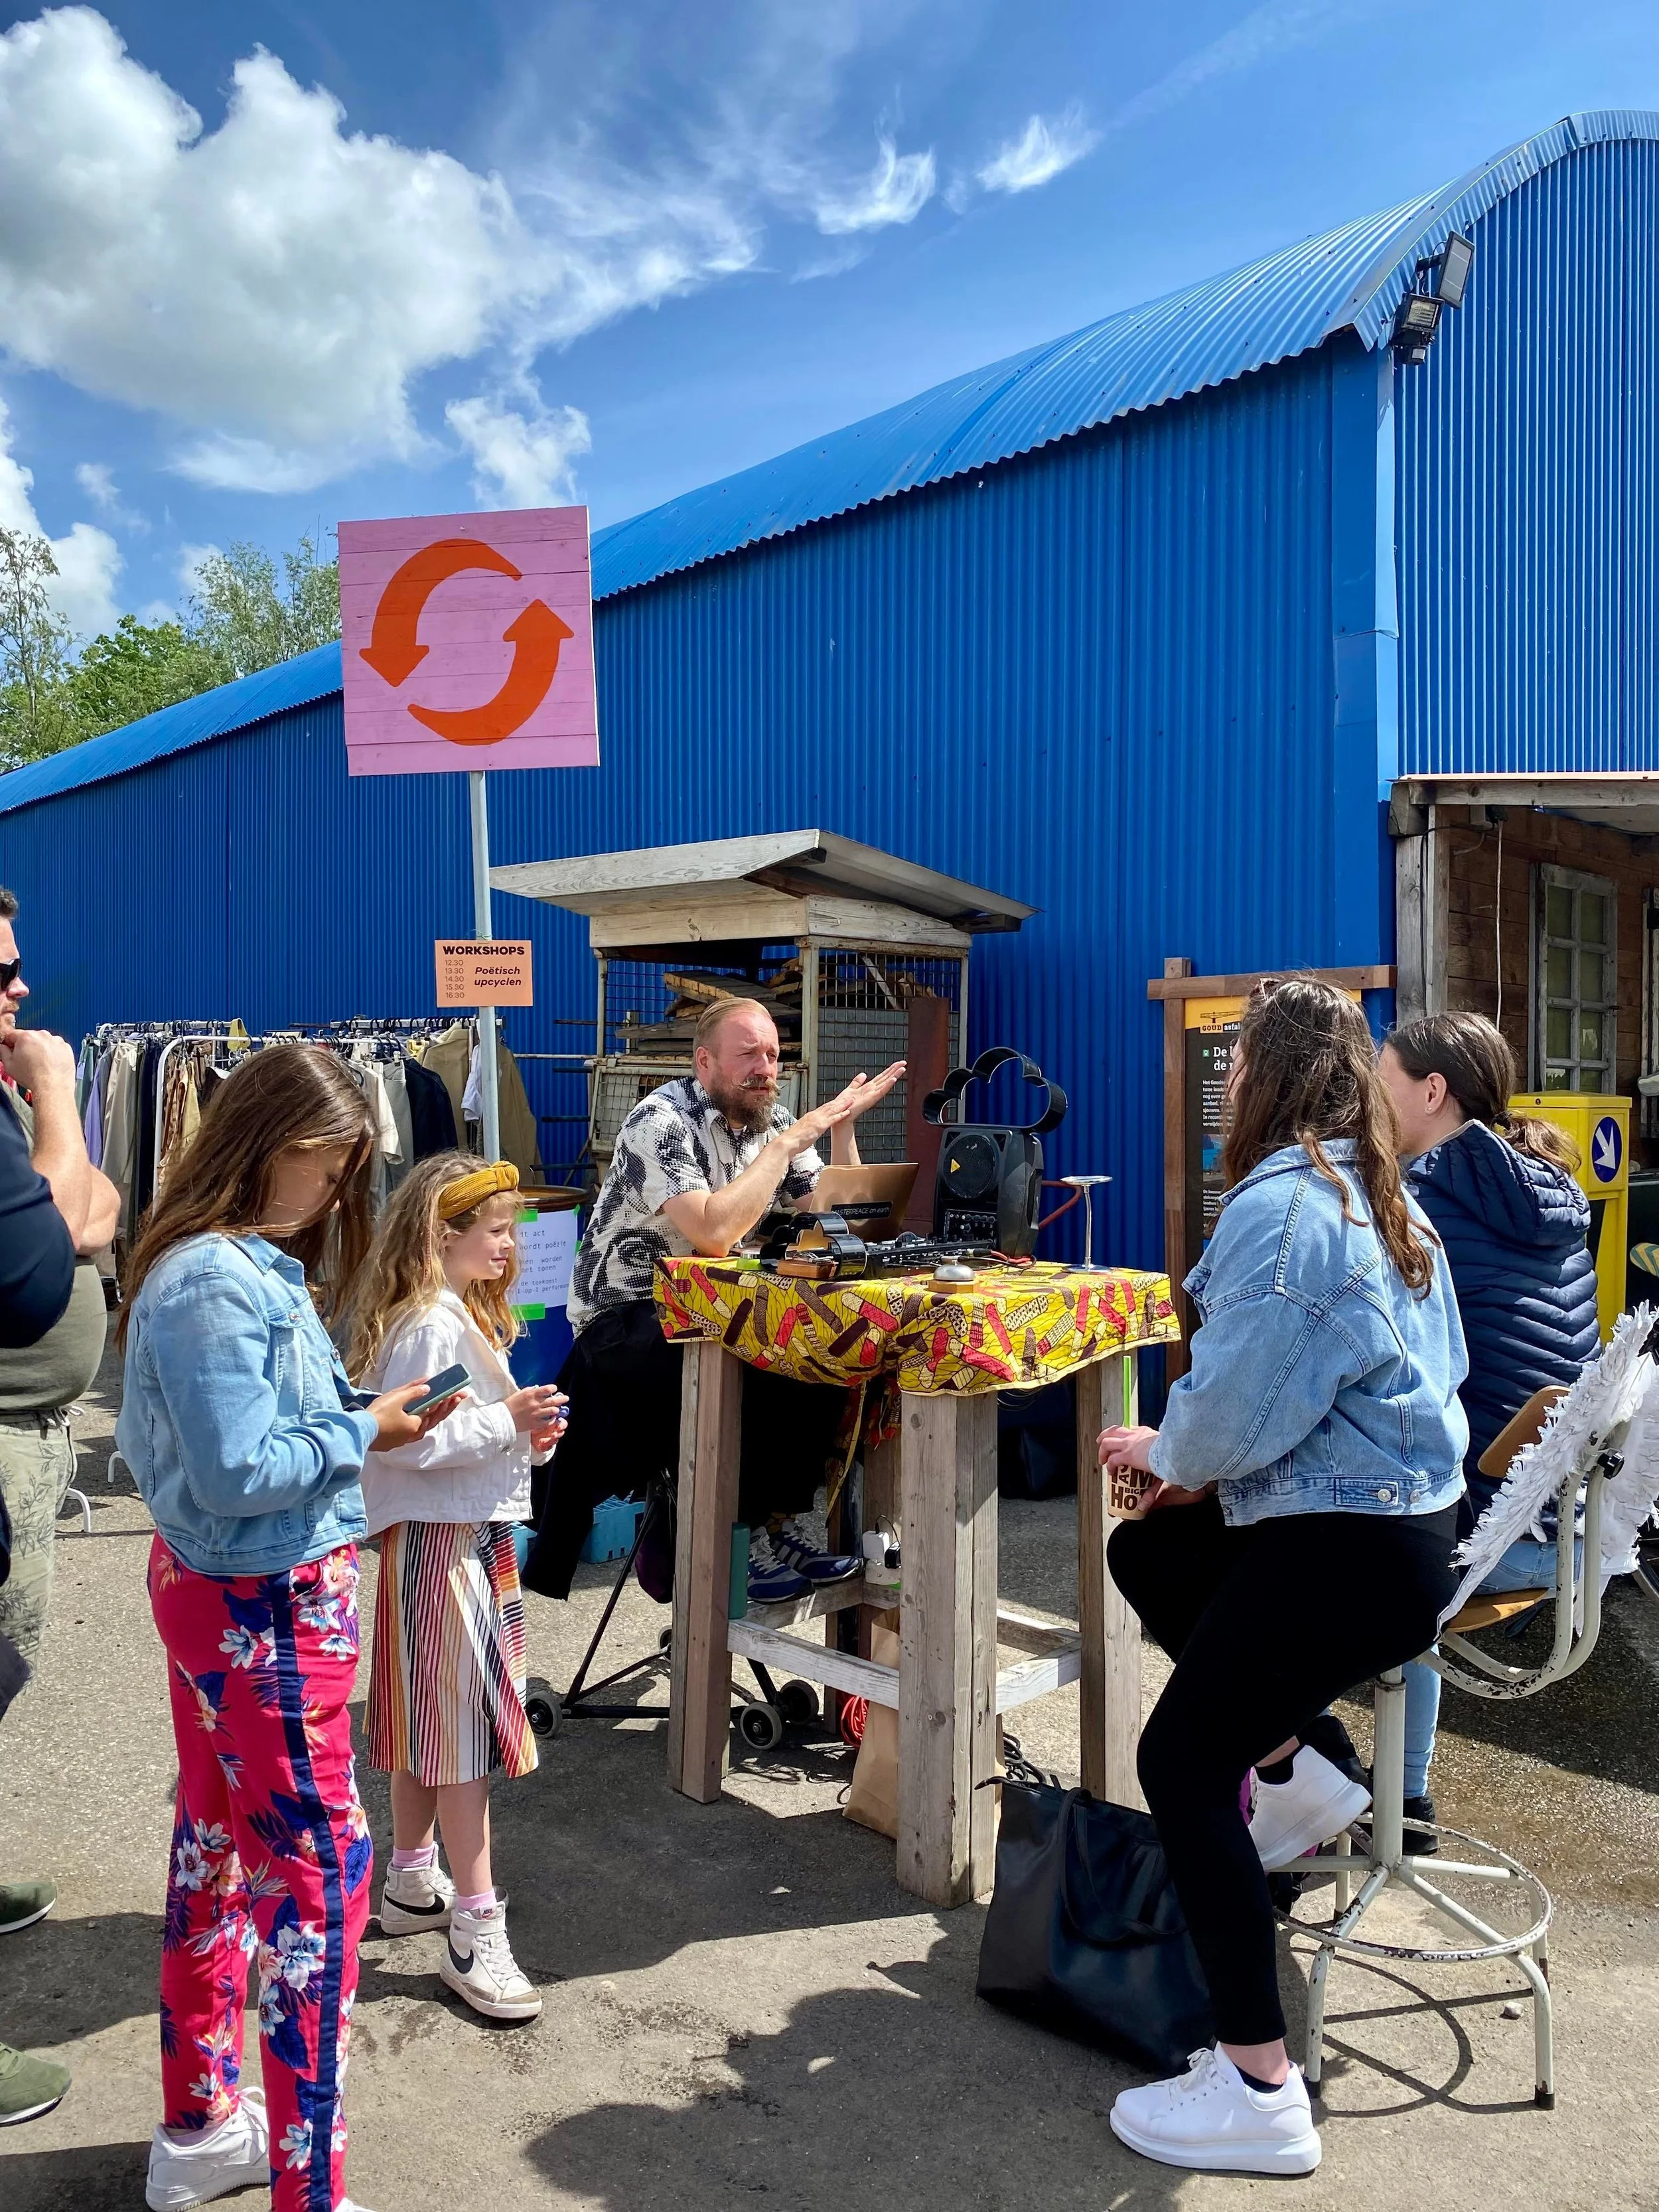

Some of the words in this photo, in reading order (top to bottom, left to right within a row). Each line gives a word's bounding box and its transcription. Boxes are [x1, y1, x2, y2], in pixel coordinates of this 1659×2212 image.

[443, 946, 525, 955] WORKSHOPS
[475, 966, 520, 975] Poëtisch
[474, 978, 522, 988] upcyclen
[1224, 1022, 1240, 1031] asfal
[1213, 1047, 1228, 1057] De
[1214, 1059, 1227, 1070] de
